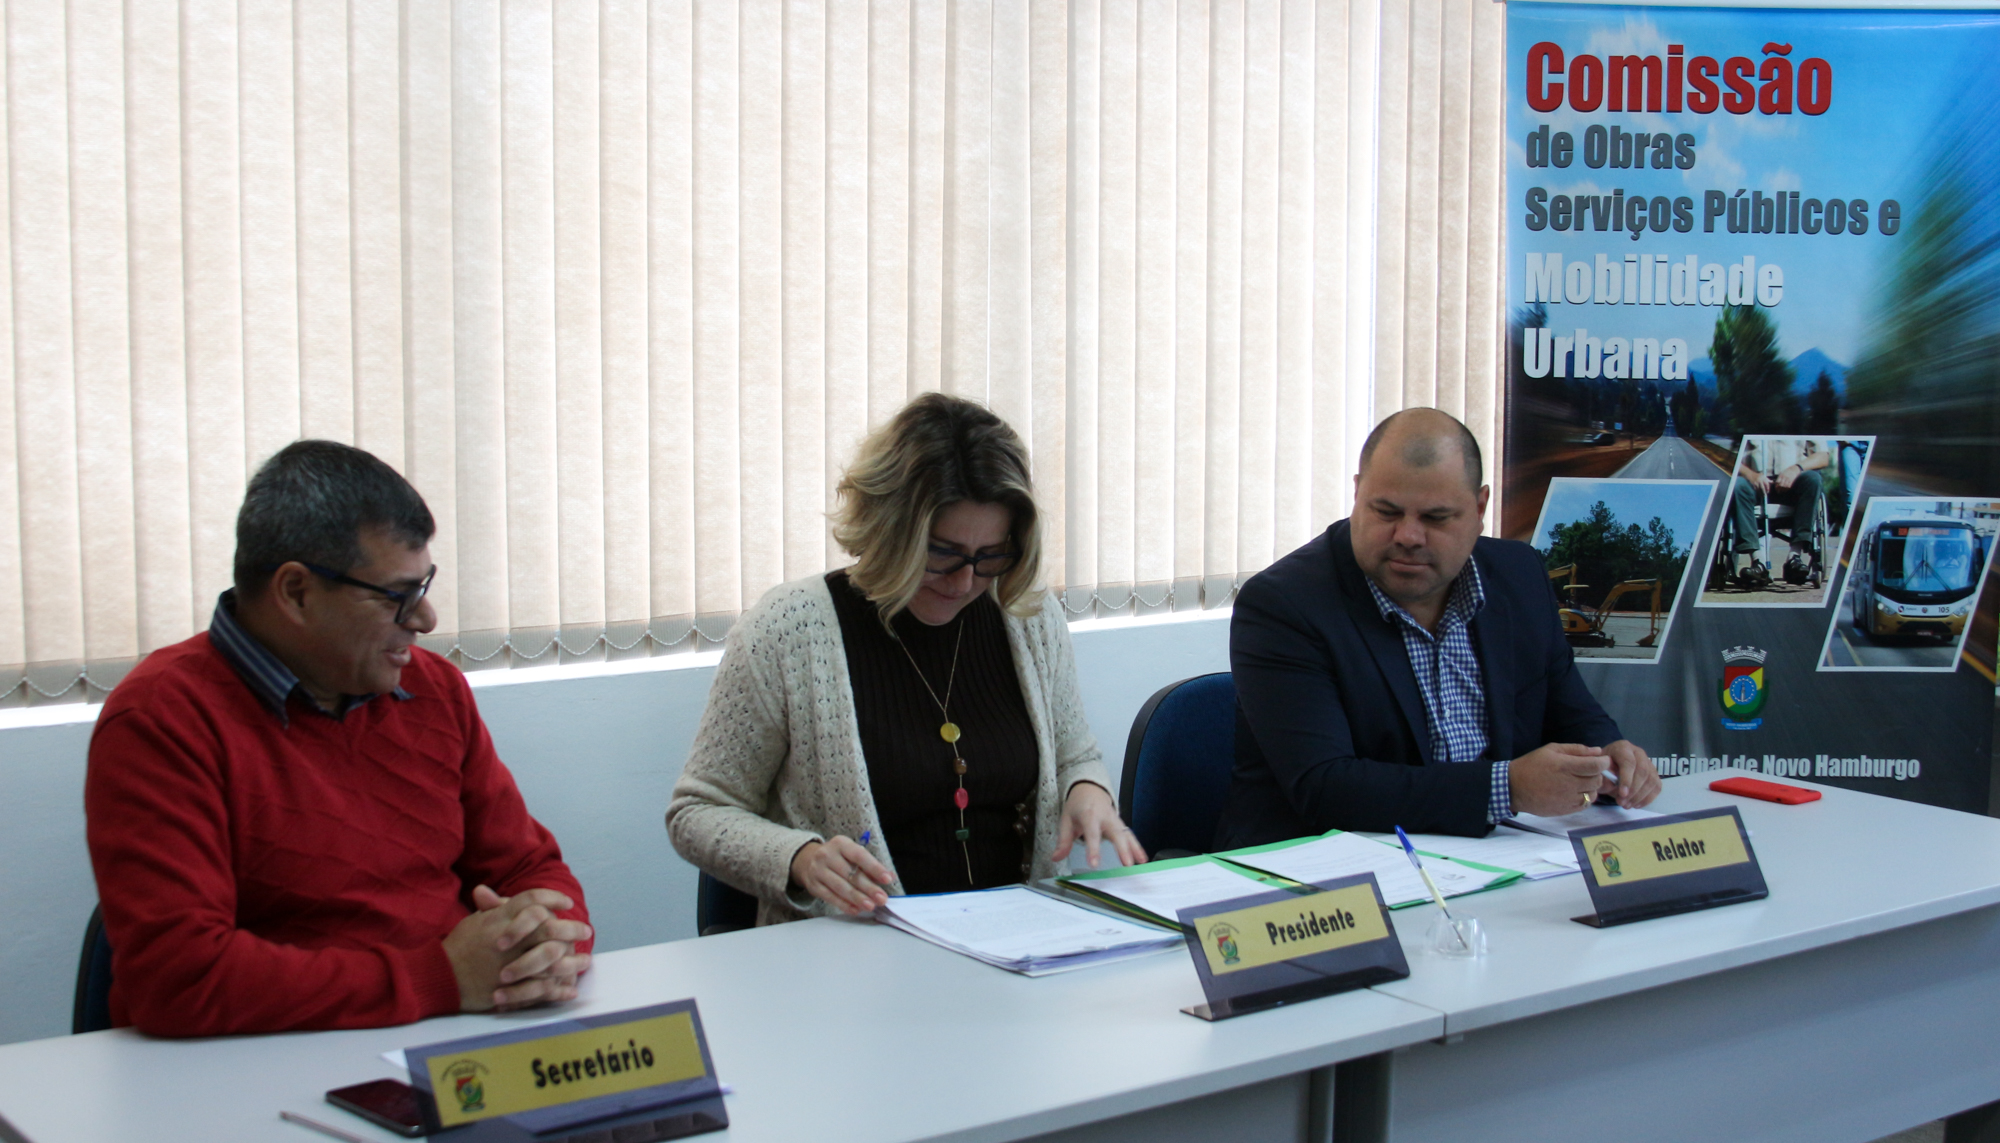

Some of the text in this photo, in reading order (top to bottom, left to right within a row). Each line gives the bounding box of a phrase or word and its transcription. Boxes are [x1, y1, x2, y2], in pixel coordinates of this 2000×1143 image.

[1525, 41, 1833, 116] Comissão
[1525, 124, 1696, 170] de Obras
[1524, 187, 1900, 241] Serviços Públicos e
[1524, 252, 1784, 307] Mobilidade
[1523, 328, 1688, 381] Urbana
[1762, 754, 1811, 777] Novo
[1814, 754, 1921, 781] Hamburgo
[1651, 837, 1706, 862] Relator
[1265, 908, 1356, 945] Presidente
[530, 1039, 656, 1088] Secretário
